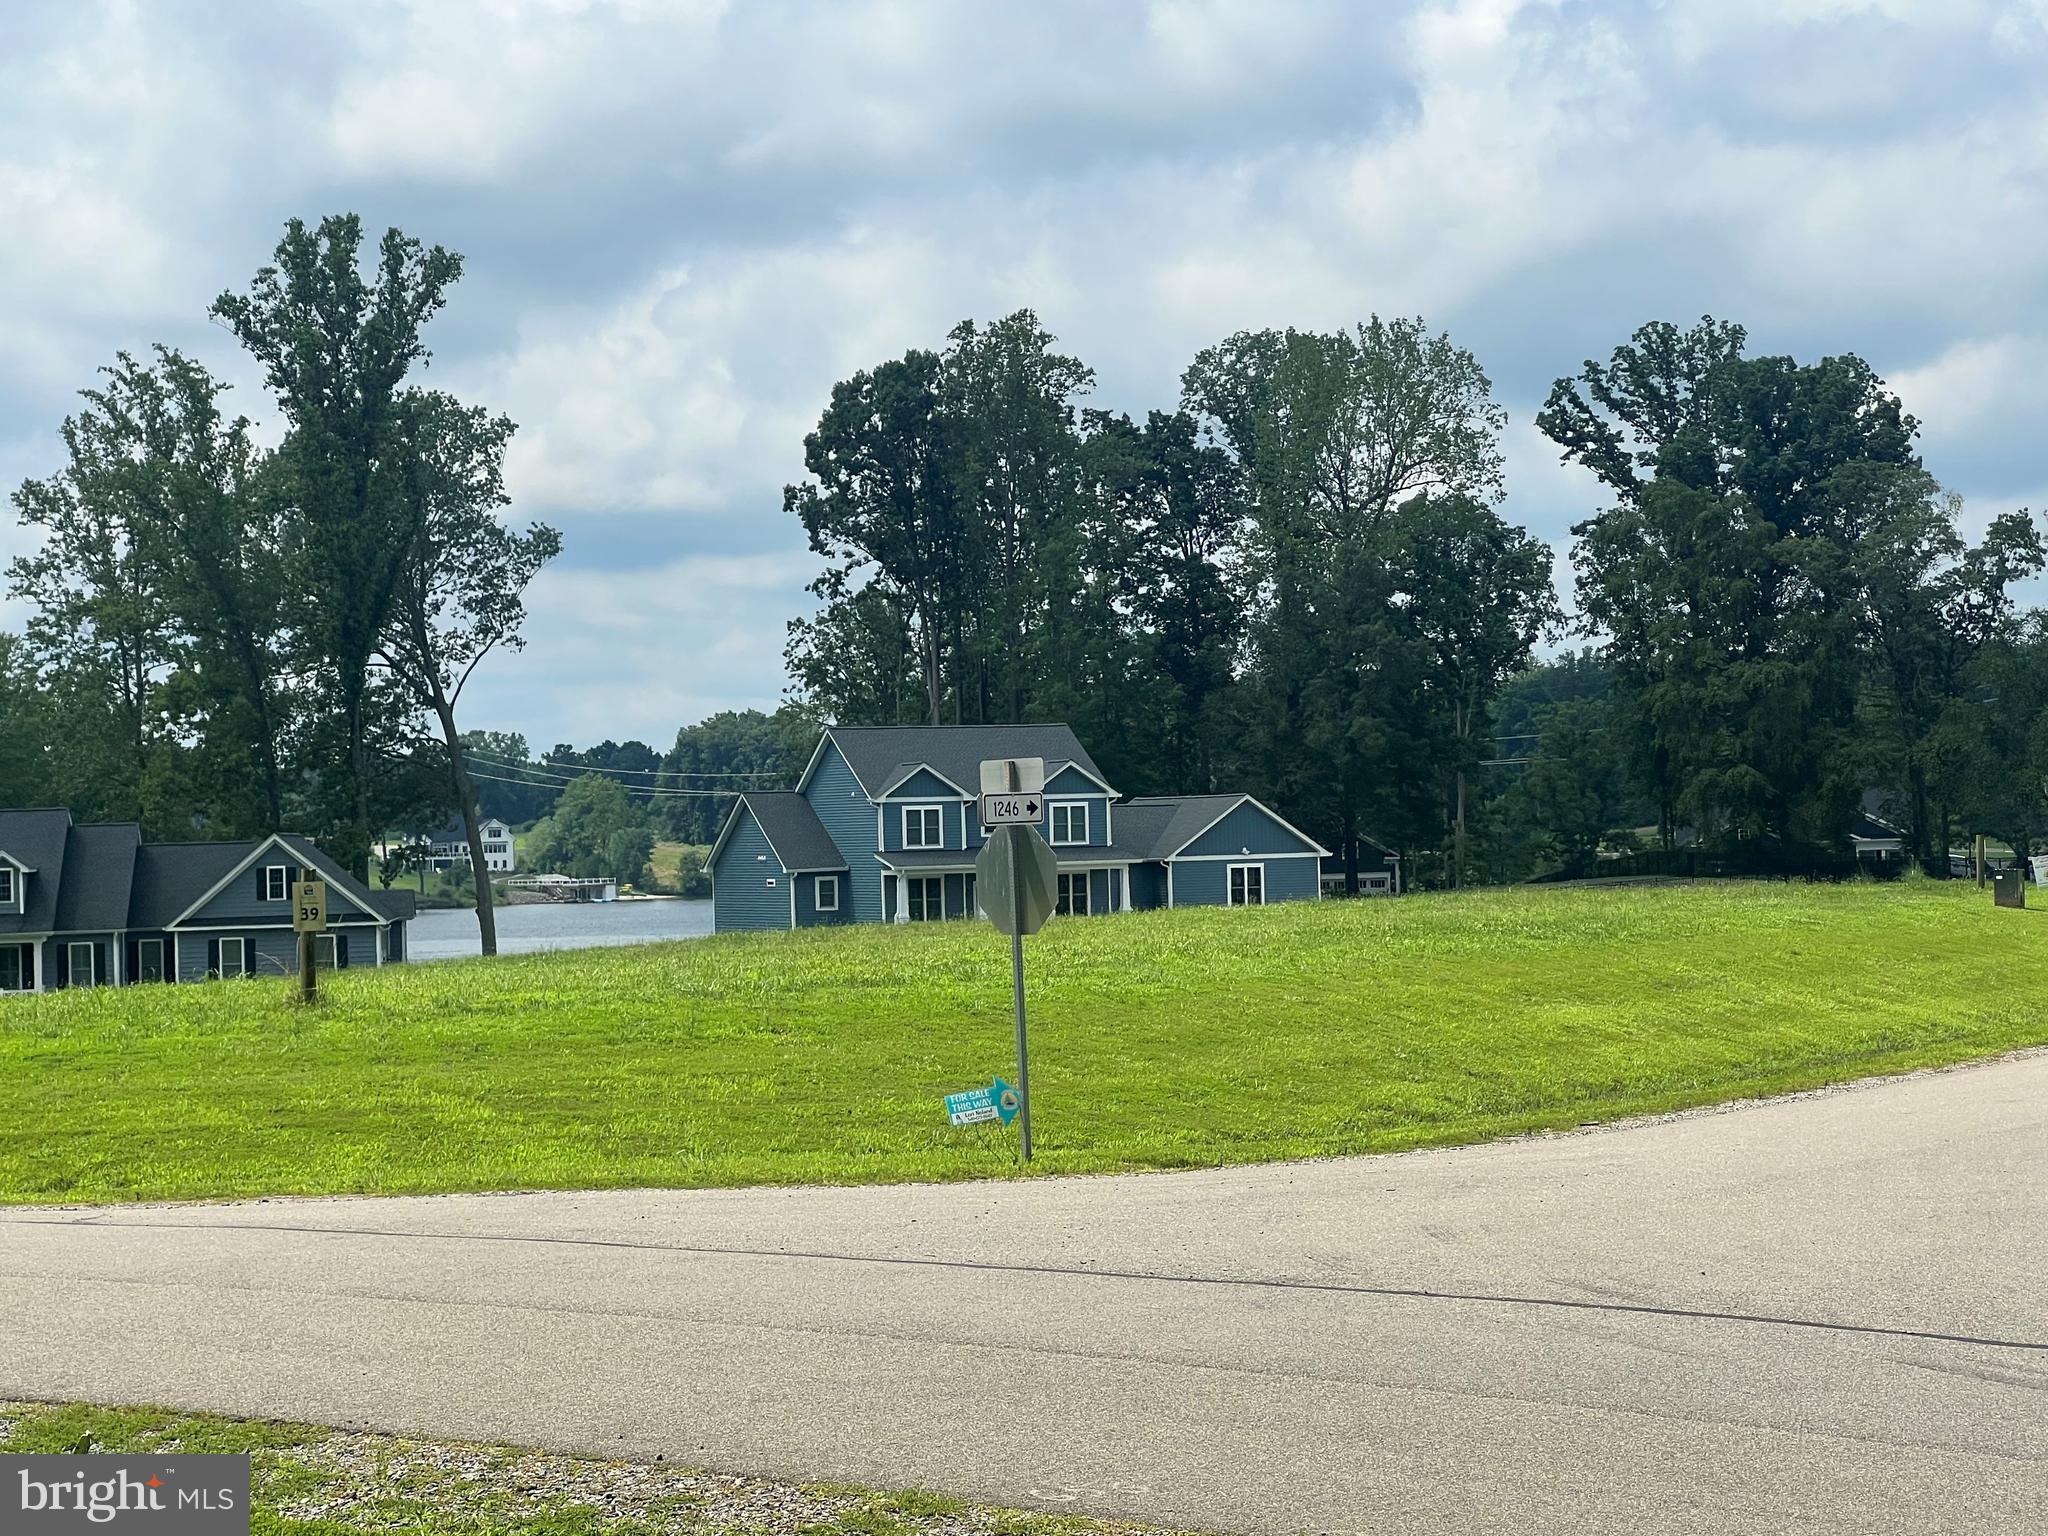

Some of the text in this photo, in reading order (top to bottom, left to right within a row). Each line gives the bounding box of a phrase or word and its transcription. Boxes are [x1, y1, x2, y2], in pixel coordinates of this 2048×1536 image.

[993, 801, 1019, 817] 1246
[300, 907, 319, 921] 39
[950, 1089, 990, 1104] FOR SALE
[951, 1098, 992, 1112] THIS WAY
